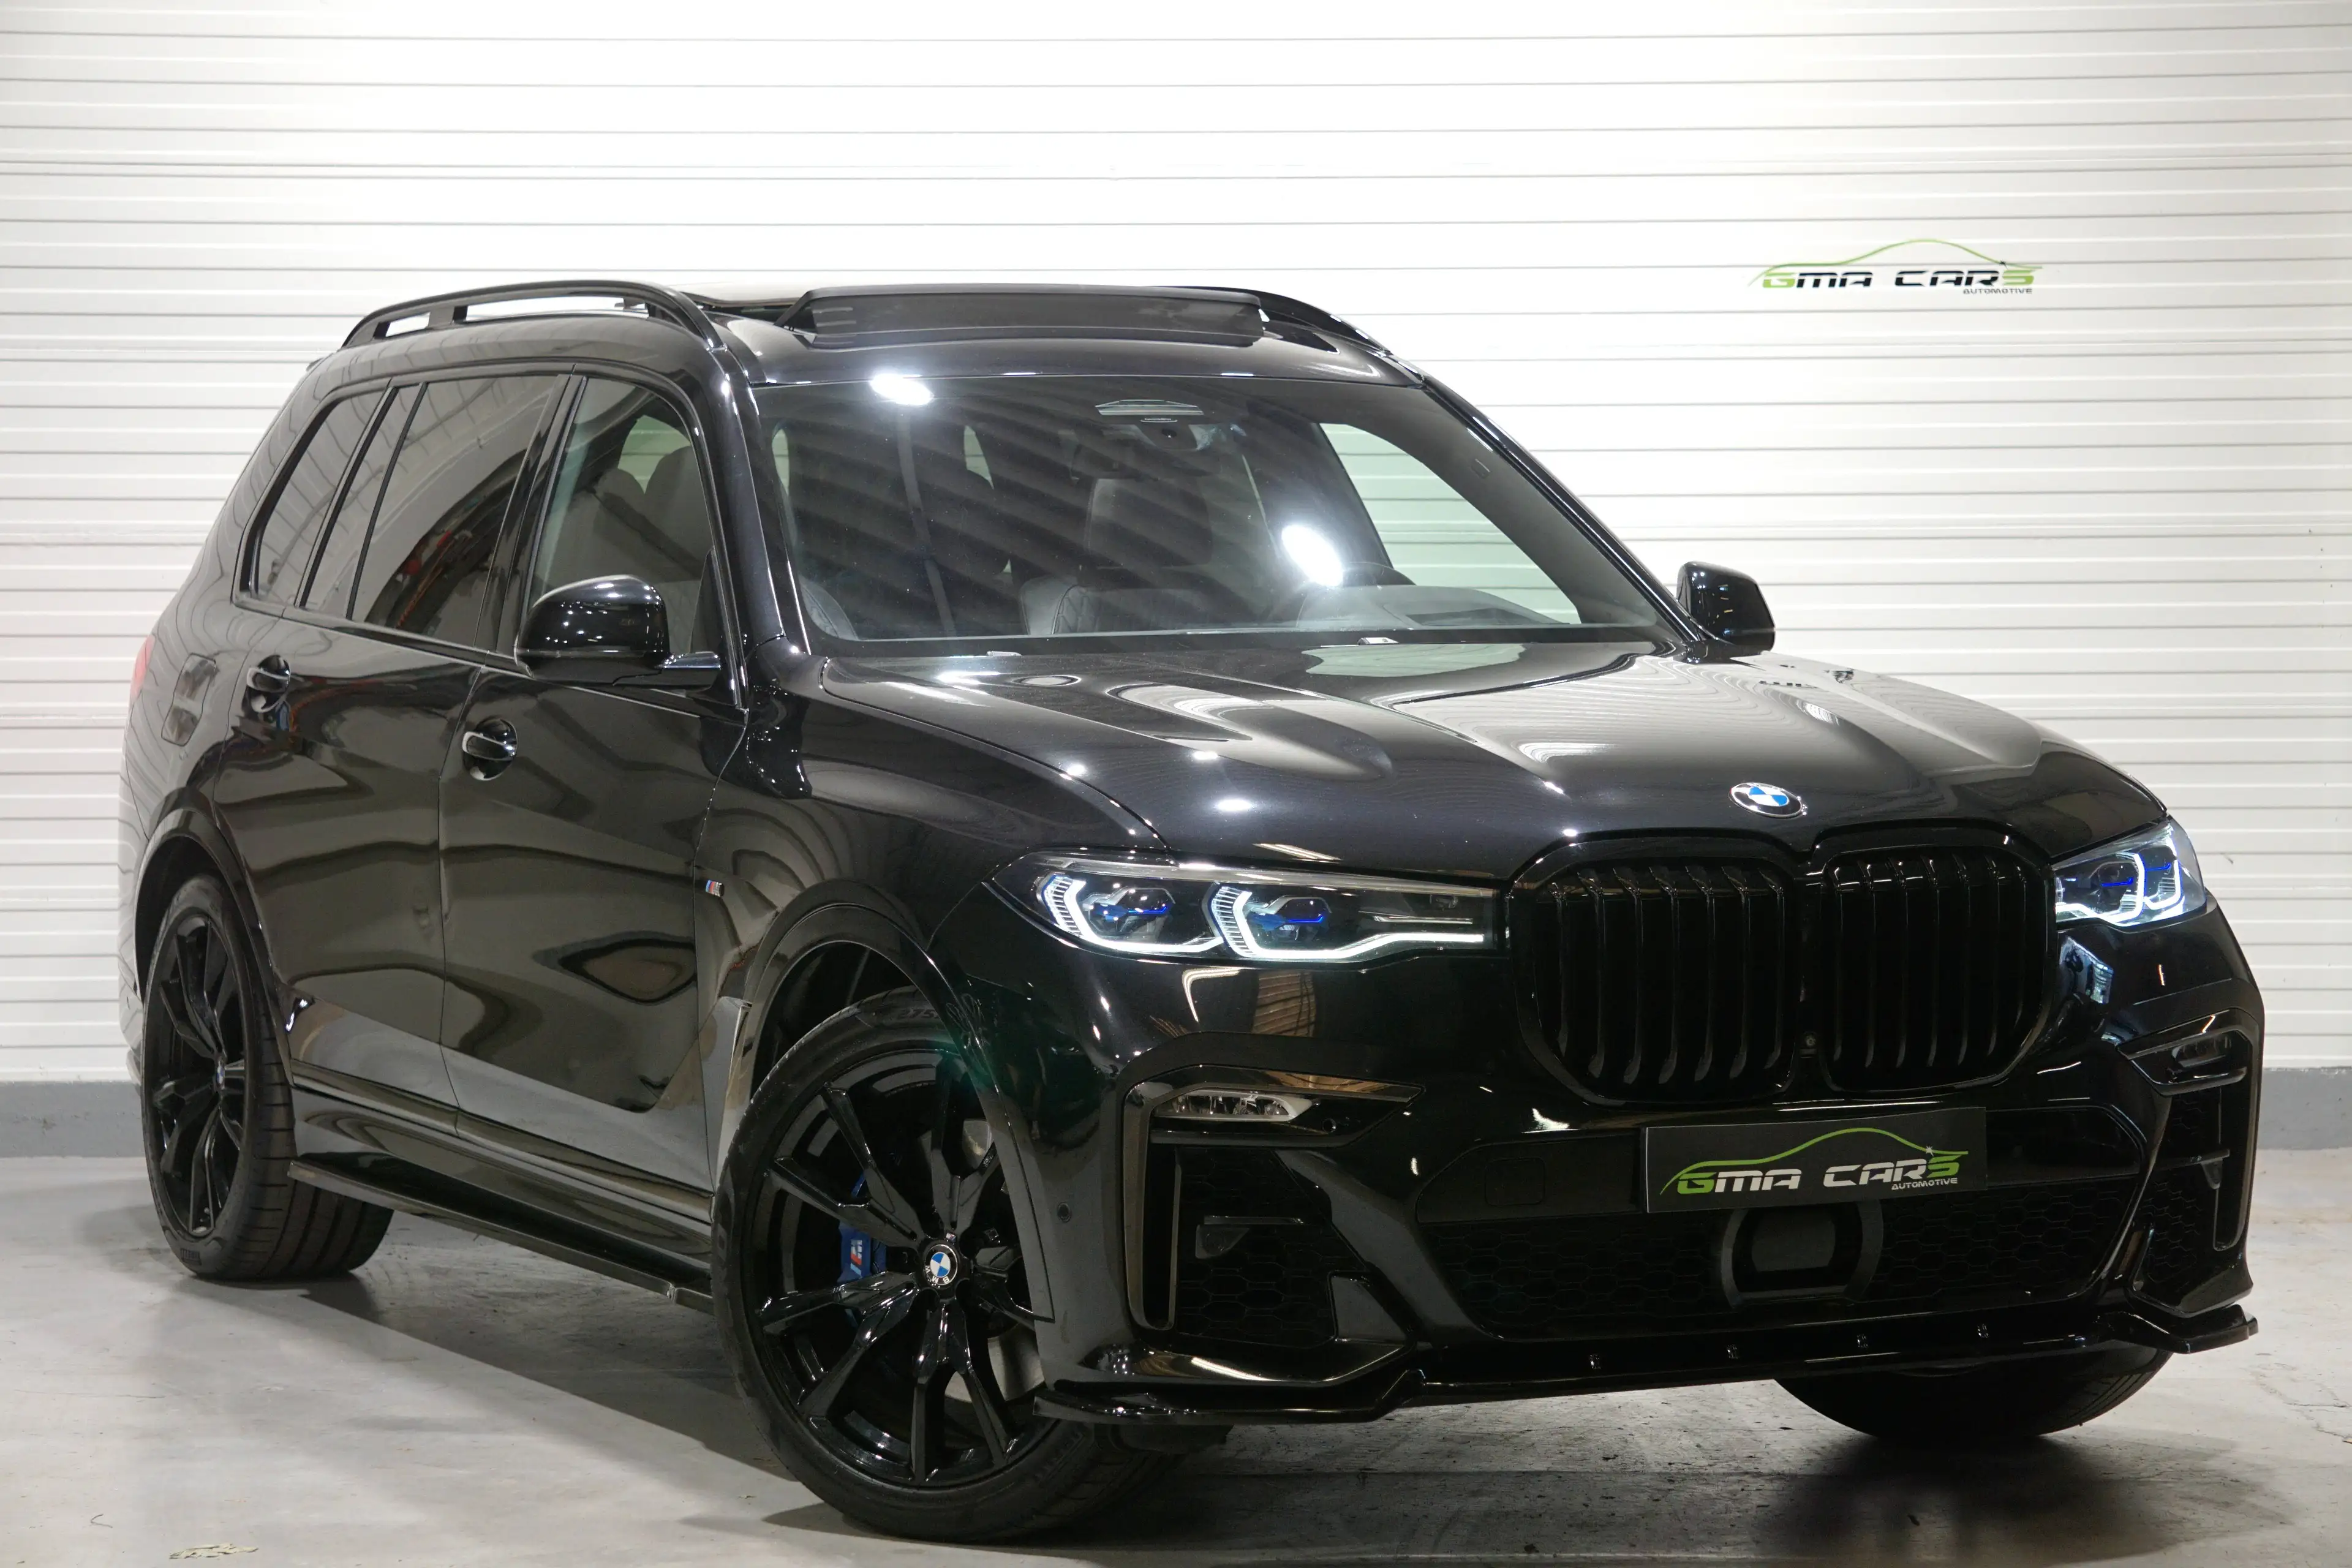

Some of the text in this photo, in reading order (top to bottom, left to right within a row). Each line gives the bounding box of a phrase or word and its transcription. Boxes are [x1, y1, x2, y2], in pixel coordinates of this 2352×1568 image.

[1762, 270, 2034, 288] GMA CARS
[1677, 1156, 1961, 1194] GMA CARS
[1891, 1178, 1958, 1190] AUTOMOTIVE
